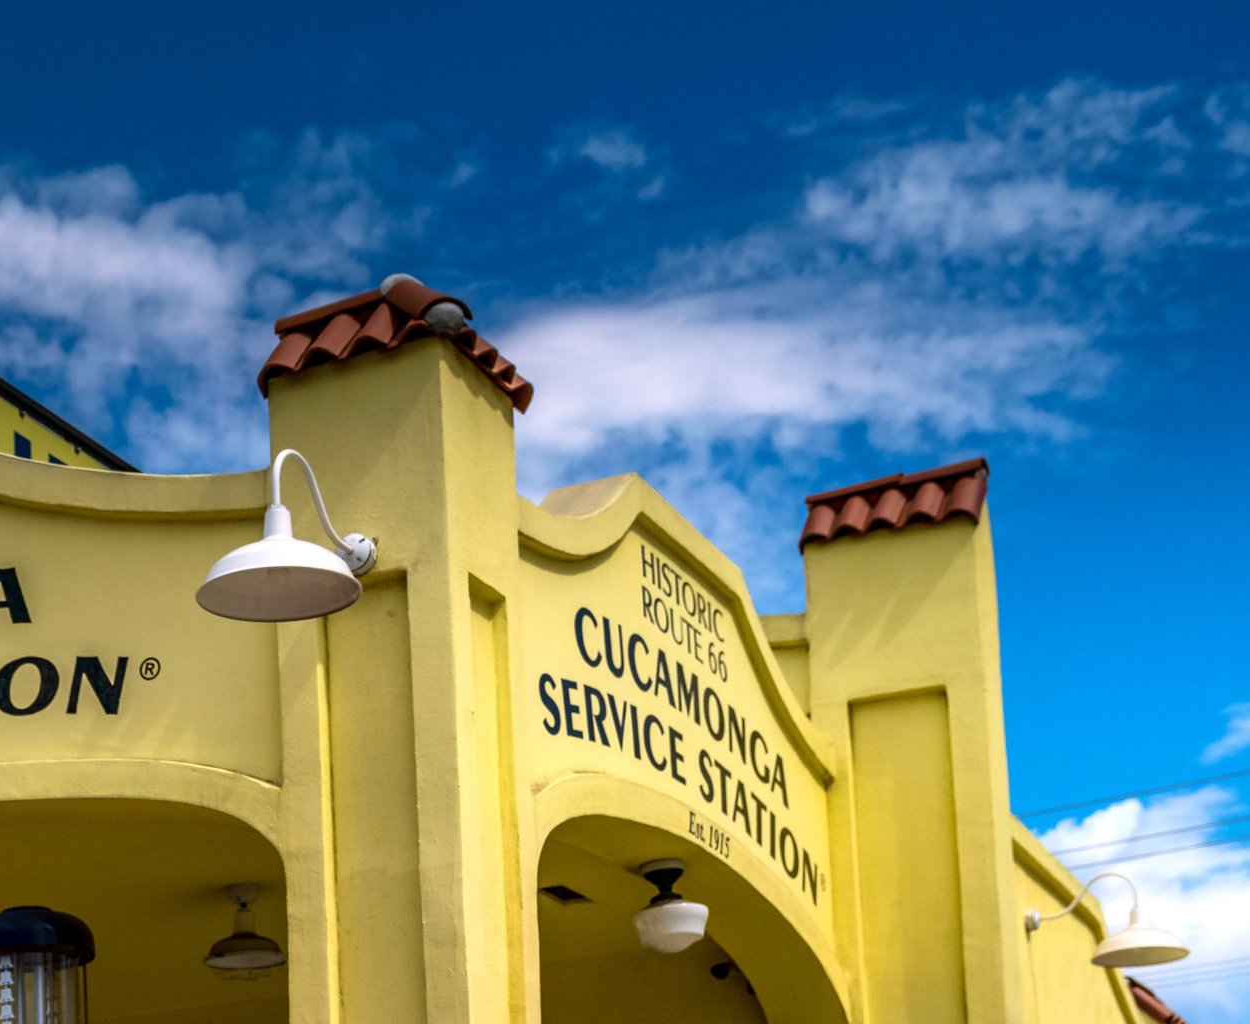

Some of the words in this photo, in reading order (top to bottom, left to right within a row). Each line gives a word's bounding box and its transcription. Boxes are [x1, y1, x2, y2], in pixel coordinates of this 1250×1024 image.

[640, 544, 726, 643] HISTORIC
[641, 585, 704, 665] ROUTE
[707, 641, 728, 684] 66
[538, 673, 687, 786] SERVICE
[573, 607, 790, 810] CUCAMONGA
[708, 825, 730, 859] 1915
